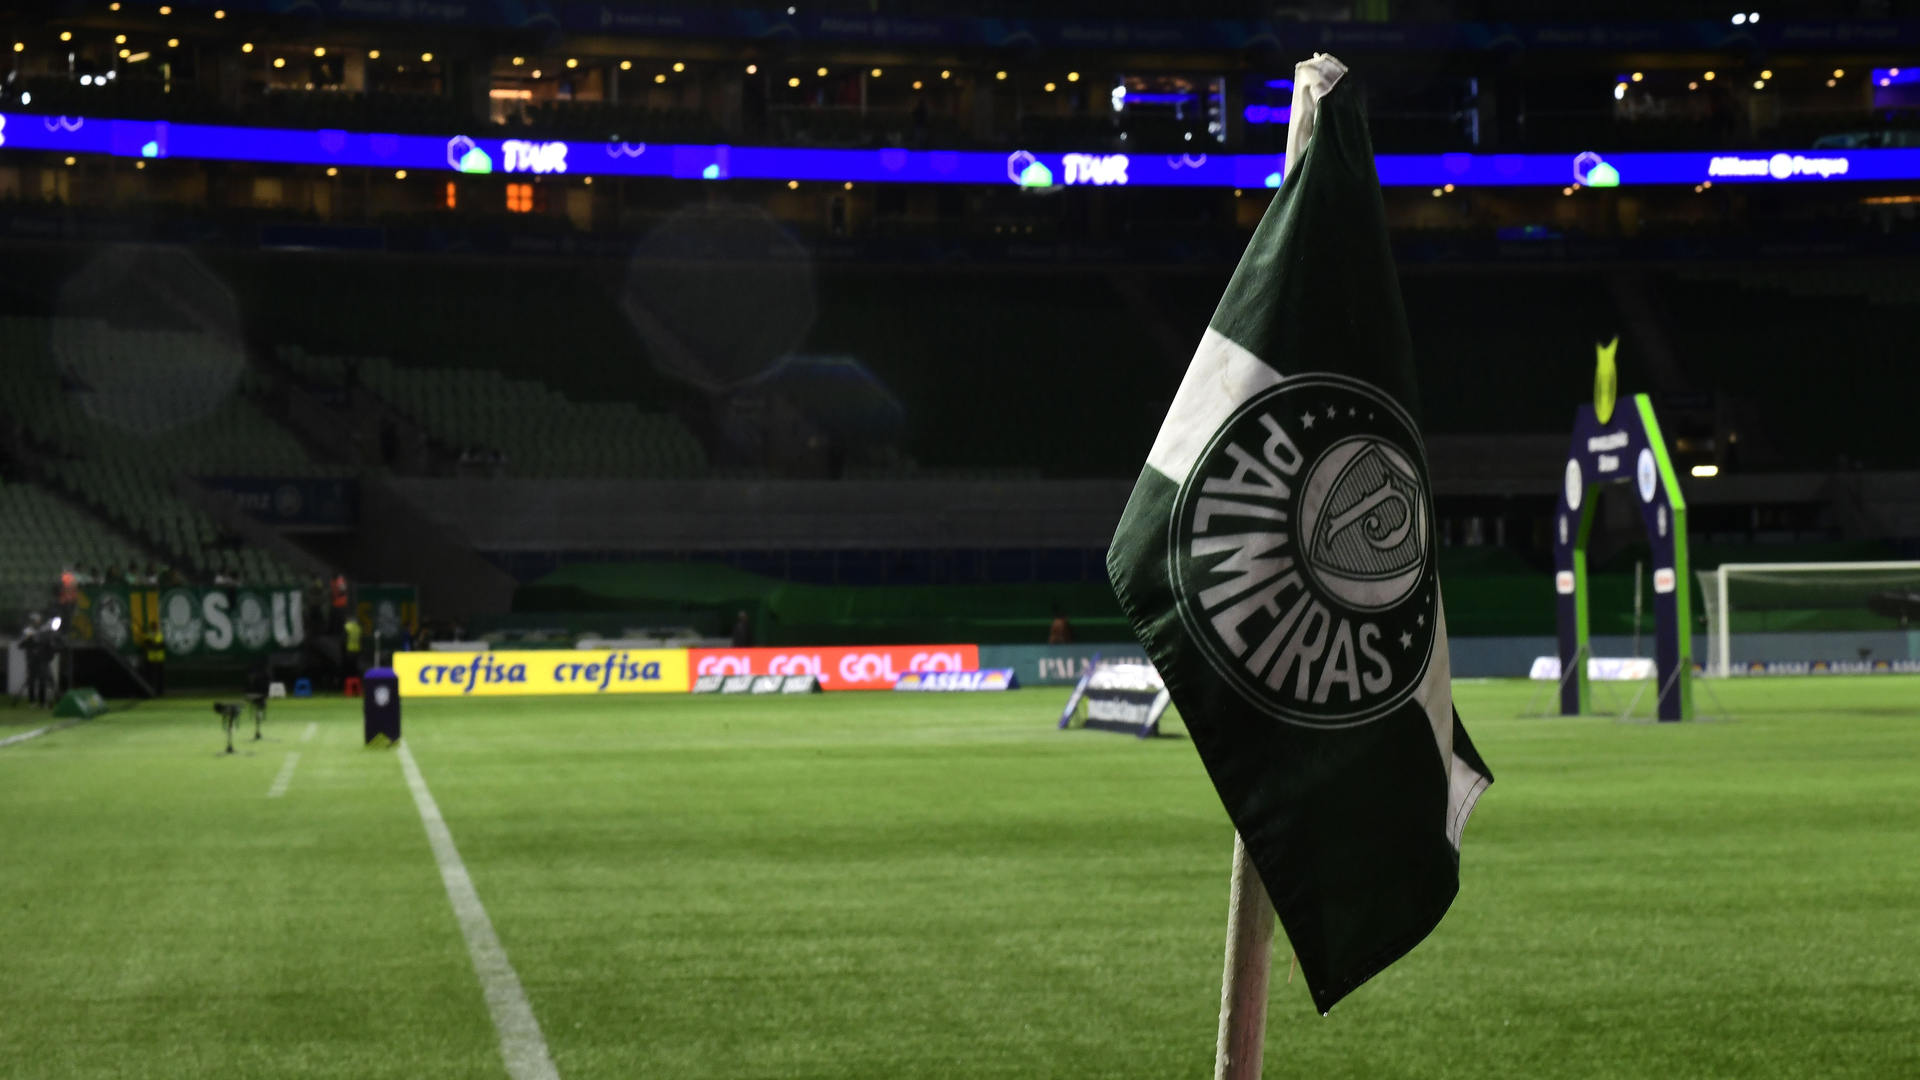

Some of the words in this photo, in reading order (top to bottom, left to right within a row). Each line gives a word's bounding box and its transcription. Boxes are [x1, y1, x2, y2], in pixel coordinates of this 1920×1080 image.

[1190, 412, 1393, 705] PALMEIRAS
[418, 655, 527, 693] crefisa
[553, 653, 661, 692] crefisa
[768, 654, 830, 683] GOL
[839, 653, 900, 682] GOL
